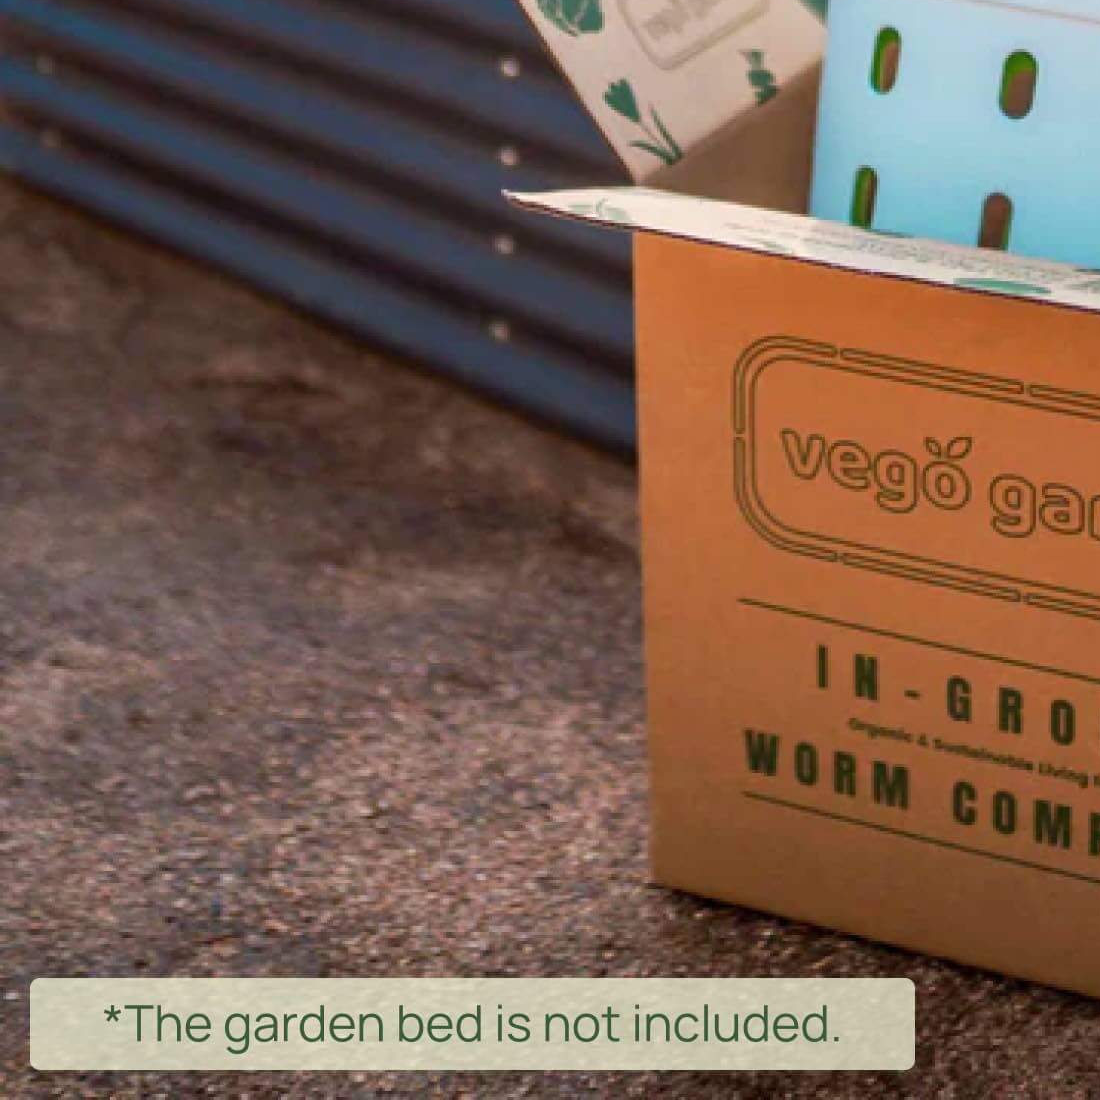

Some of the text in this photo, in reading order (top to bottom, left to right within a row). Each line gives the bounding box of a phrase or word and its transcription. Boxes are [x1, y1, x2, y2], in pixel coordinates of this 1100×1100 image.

[781, 428, 972, 514] vego
[744, 729, 910, 811] WORM
[848, 717, 913, 744] Organic
[1038, 762, 1089, 788] Living
